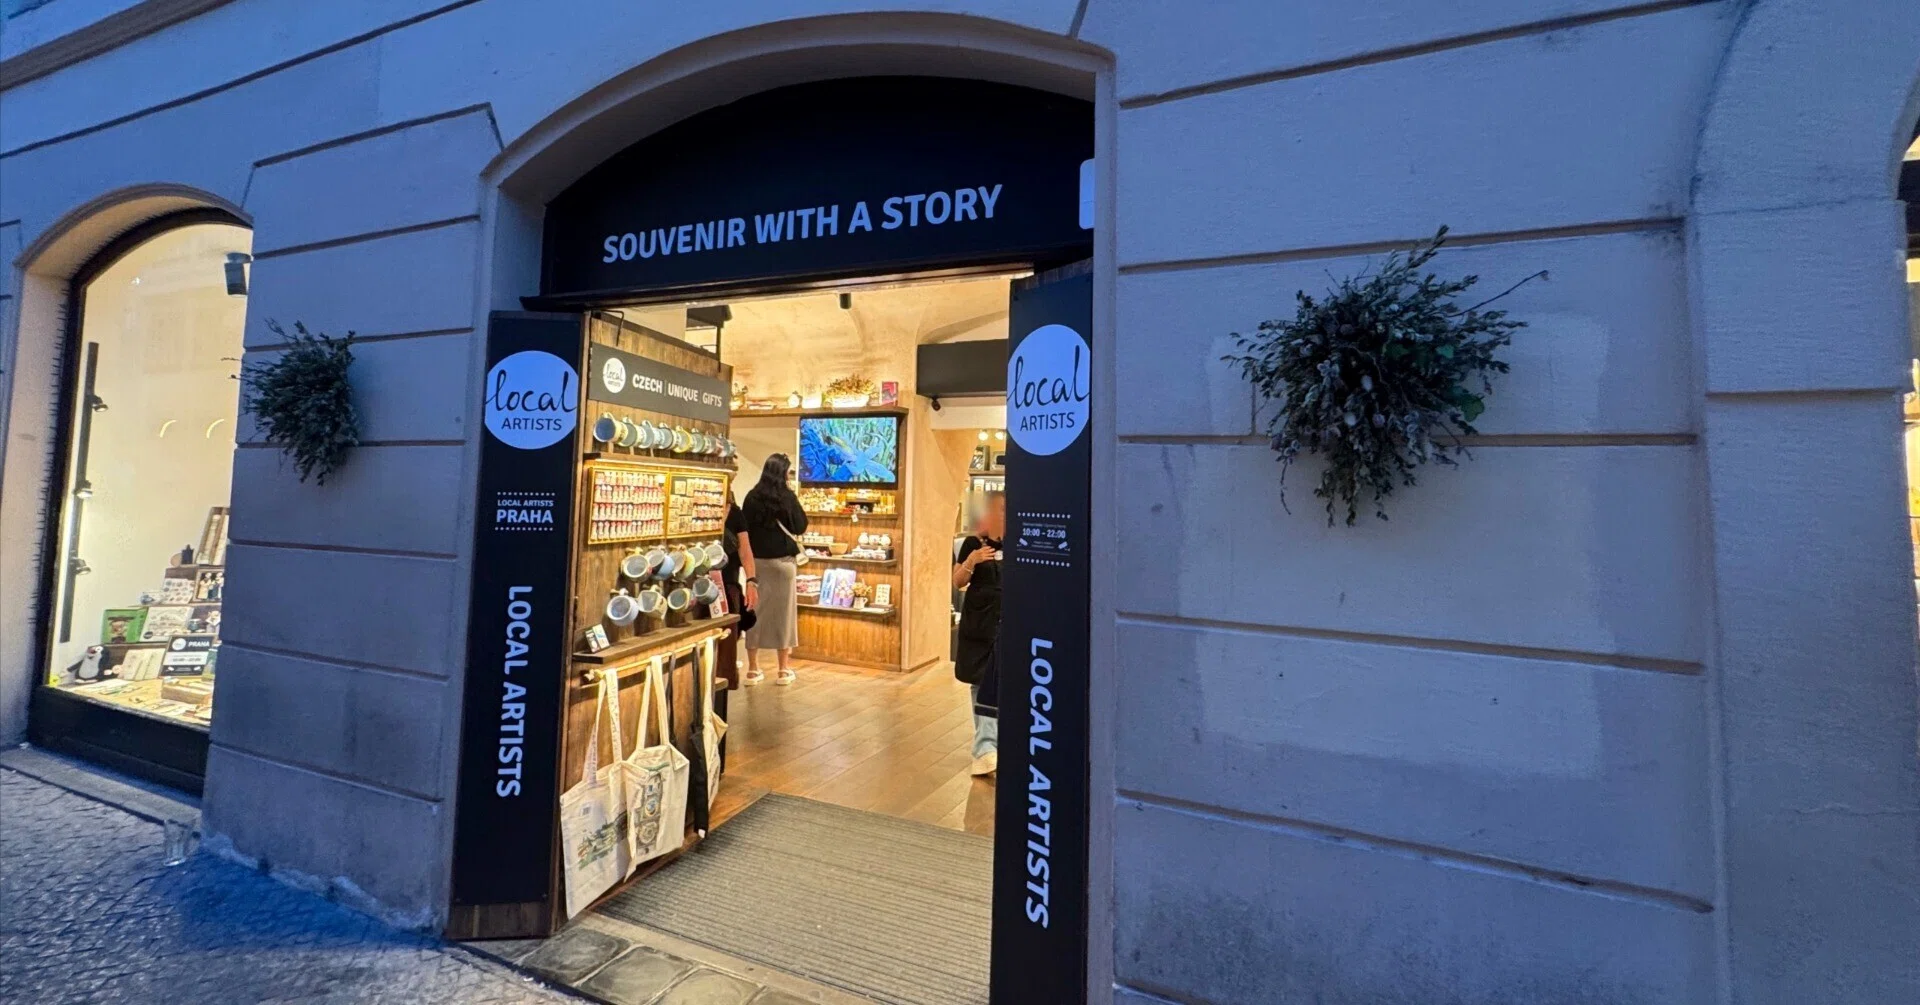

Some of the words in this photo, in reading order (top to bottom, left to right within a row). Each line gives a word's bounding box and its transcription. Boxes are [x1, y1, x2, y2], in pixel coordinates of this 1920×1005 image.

[602, 217, 746, 263] SOUVENIR
[754, 204, 838, 244] WITH
[847, 201, 873, 233] A
[881, 184, 1003, 230] STORY
[486, 369, 577, 413] local
[632, 374, 663, 394] CZECH
[668, 382, 698, 402] UNIQUE
[702, 392, 722, 408] GIFTS
[1007, 345, 1090, 409] local
[501, 417, 562, 431] ARTISTS
[1020, 412, 1075, 431] ARTISTS
[496, 509, 554, 524] PRAHA
[497, 499, 522, 507] LOCAL
[523, 499, 554, 507] ARTISTS
[1022, 528, 1041, 537] 10:00
[1046, 529, 1066, 538] 22:00
[504, 586, 533, 675] LOCAL
[1029, 637, 1053, 756] LOCAL
[496, 681, 527, 798] ARTISTS
[1025, 764, 1051, 929] ARTISTS
